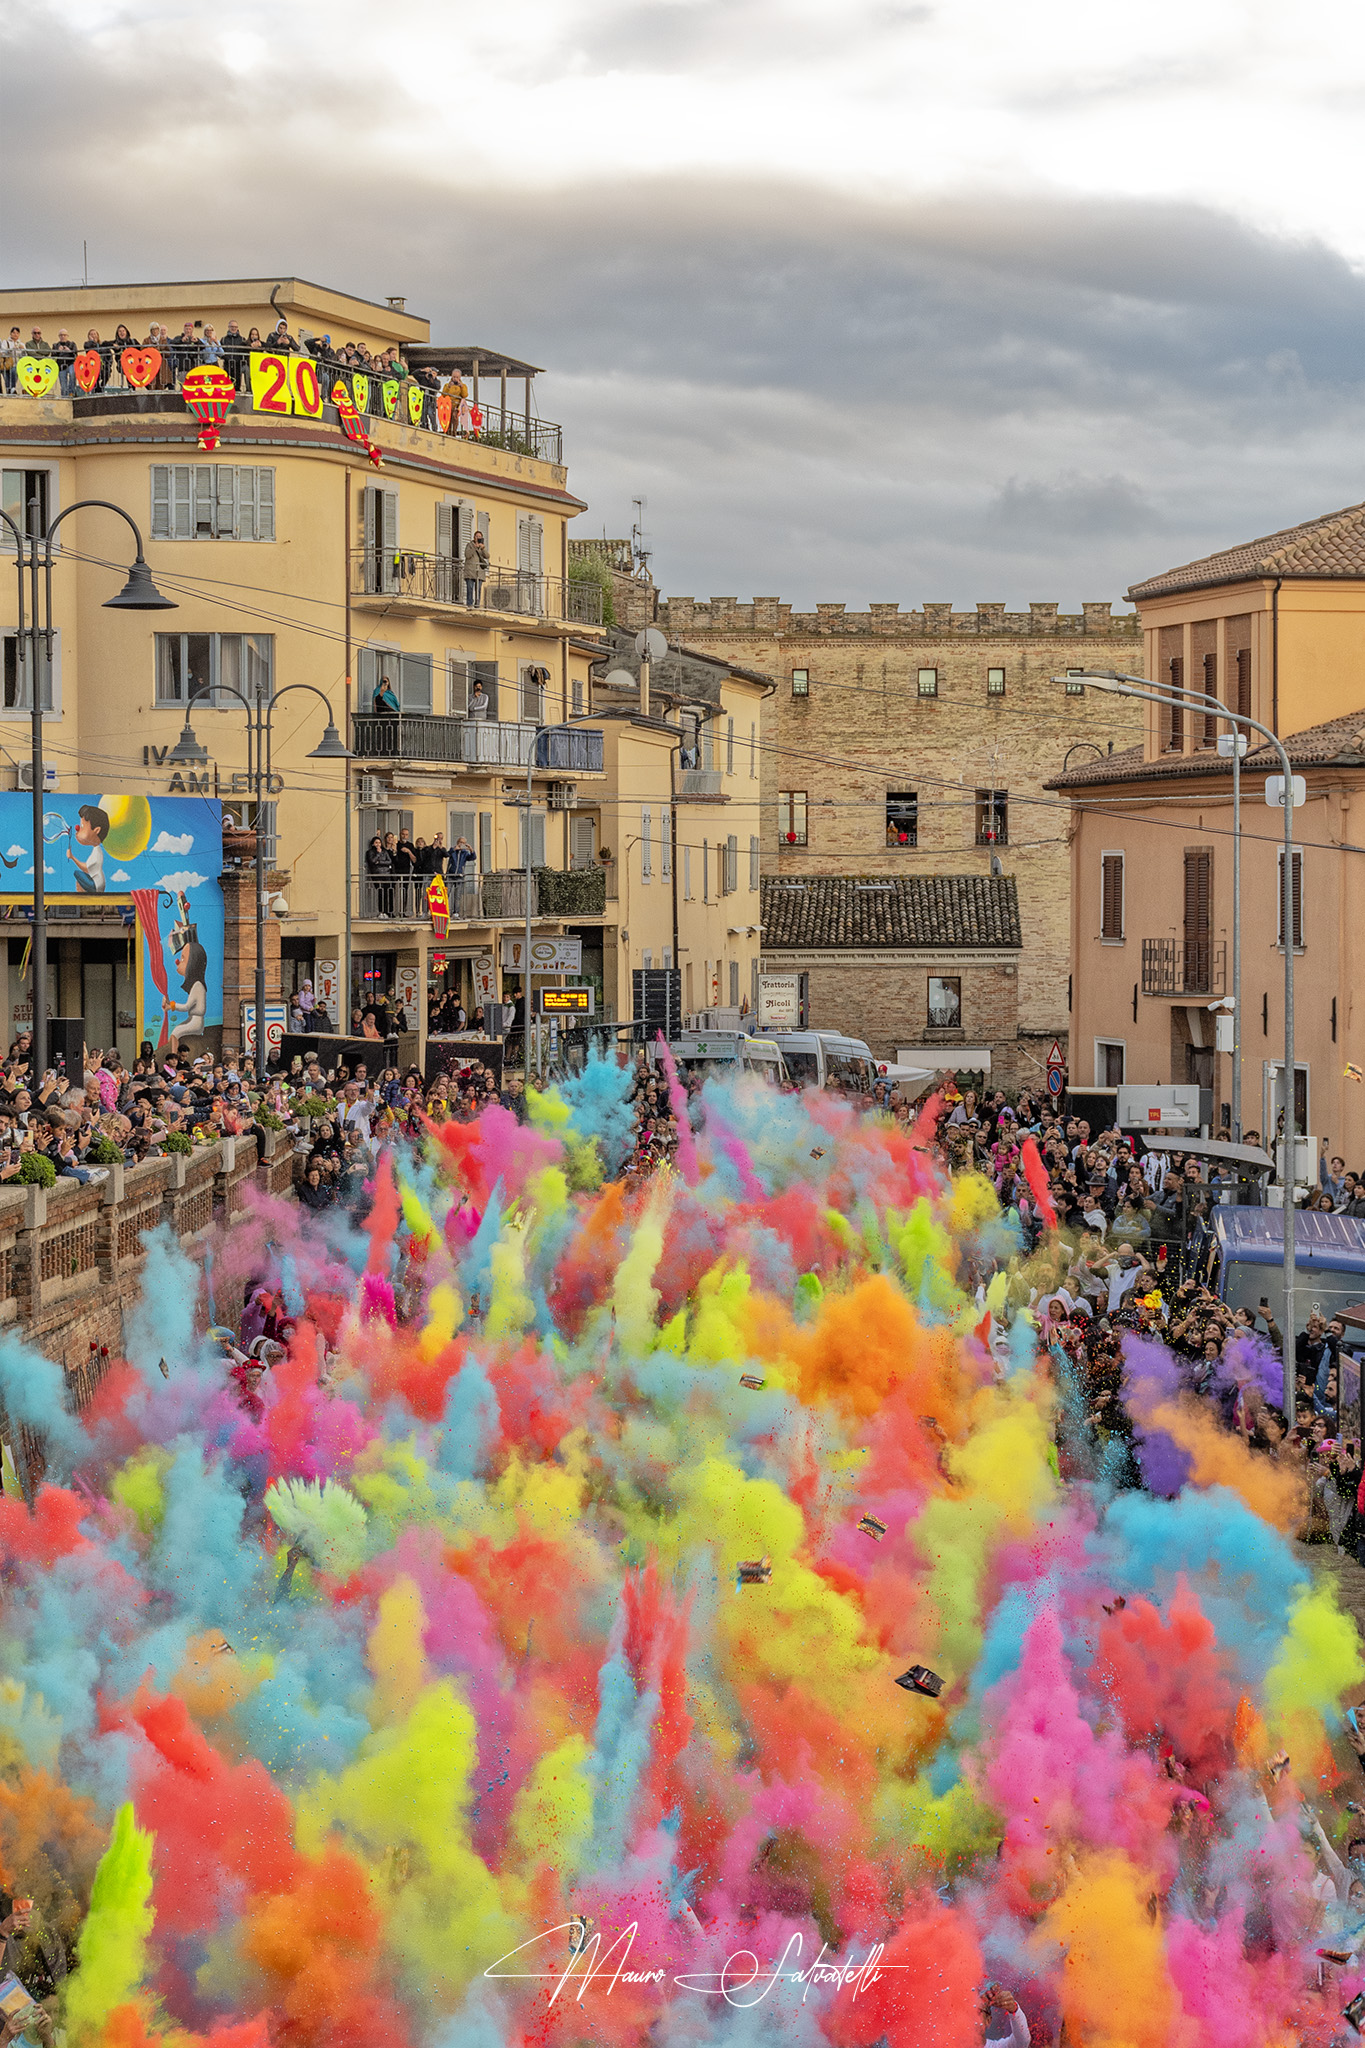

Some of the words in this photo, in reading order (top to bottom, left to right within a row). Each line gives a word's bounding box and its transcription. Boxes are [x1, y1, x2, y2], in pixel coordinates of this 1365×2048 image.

[259, 357, 320, 414] 20
[761, 981, 795, 989] Trattoria
[14, 1004, 52, 1013] STUO
[13, 1012, 54, 1021] MEDO
